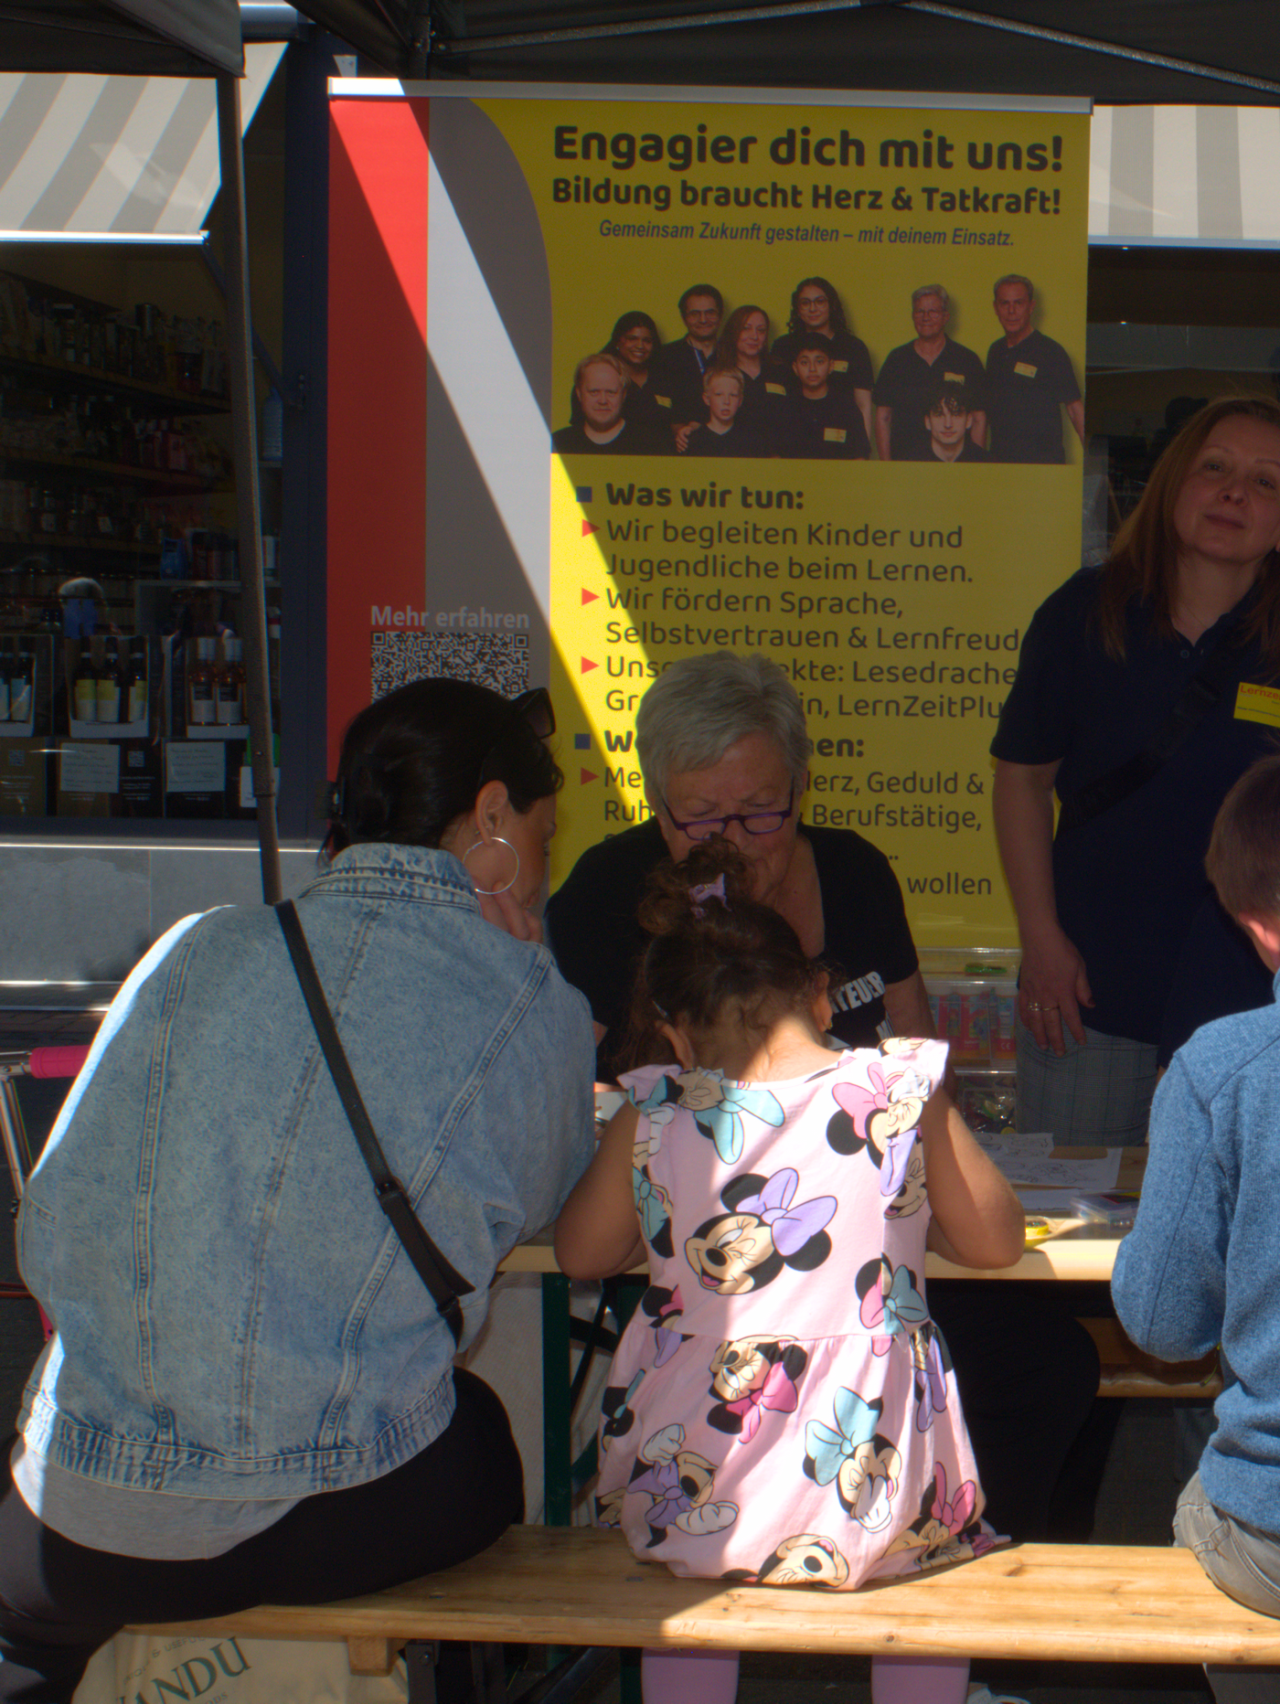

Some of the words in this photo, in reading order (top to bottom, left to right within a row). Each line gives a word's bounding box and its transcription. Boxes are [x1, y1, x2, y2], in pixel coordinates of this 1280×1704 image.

[553, 124, 757, 171] Engagier
[769, 126, 865, 167] dich
[879, 130, 954, 169] mit
[967, 136, 1063, 172] uns!
[552, 177, 671, 211] Bildung
[680, 179, 803, 209] braucht
[812, 184, 884, 210] Herz
[891, 186, 913, 211] &
[921, 187, 1061, 215] Tatkraft!
[600, 220, 694, 239] Gemeinsam
[700, 222, 761, 241] Zukunft
[766, 223, 839, 244] gestalten
[858, 226, 884, 243] mit
[886, 226, 947, 245] deinem
[951, 228, 1015, 247] Einsatz.
[606, 483, 672, 507] Was
[680, 481, 732, 508] wir
[741, 486, 804, 510] tun:
[606, 518, 654, 542] Wir
[663, 519, 797, 549] begleiten
[808, 522, 901, 547] Kinder
[909, 525, 963, 548] und
[606, 554, 779, 582] Jugendliche
[788, 556, 857, 580] beim
[867, 559, 973, 583] Lernen.
[371, 605, 429, 627] Mehr
[435, 605, 530, 629] erfahren
[606, 586, 654, 610] Wir
[662, 587, 771, 612] fördern
[780, 591, 902, 619] Sprache,
[606, 621, 839, 648] Selbstvertrauen
[848, 627, 867, 649] &
[877, 627, 1019, 651] Lernfreud
[606, 656, 672, 679] Uns
[853, 661, 1018, 685] Lesedrache
[838, 694, 1003, 719] LernZeitPlu
[867, 771, 957, 794] Geduld
[966, 773, 984, 795] &
[604, 800, 655, 822] Ruh
[812, 803, 981, 834] Berufstätige,
[907, 872, 992, 896] wollen
